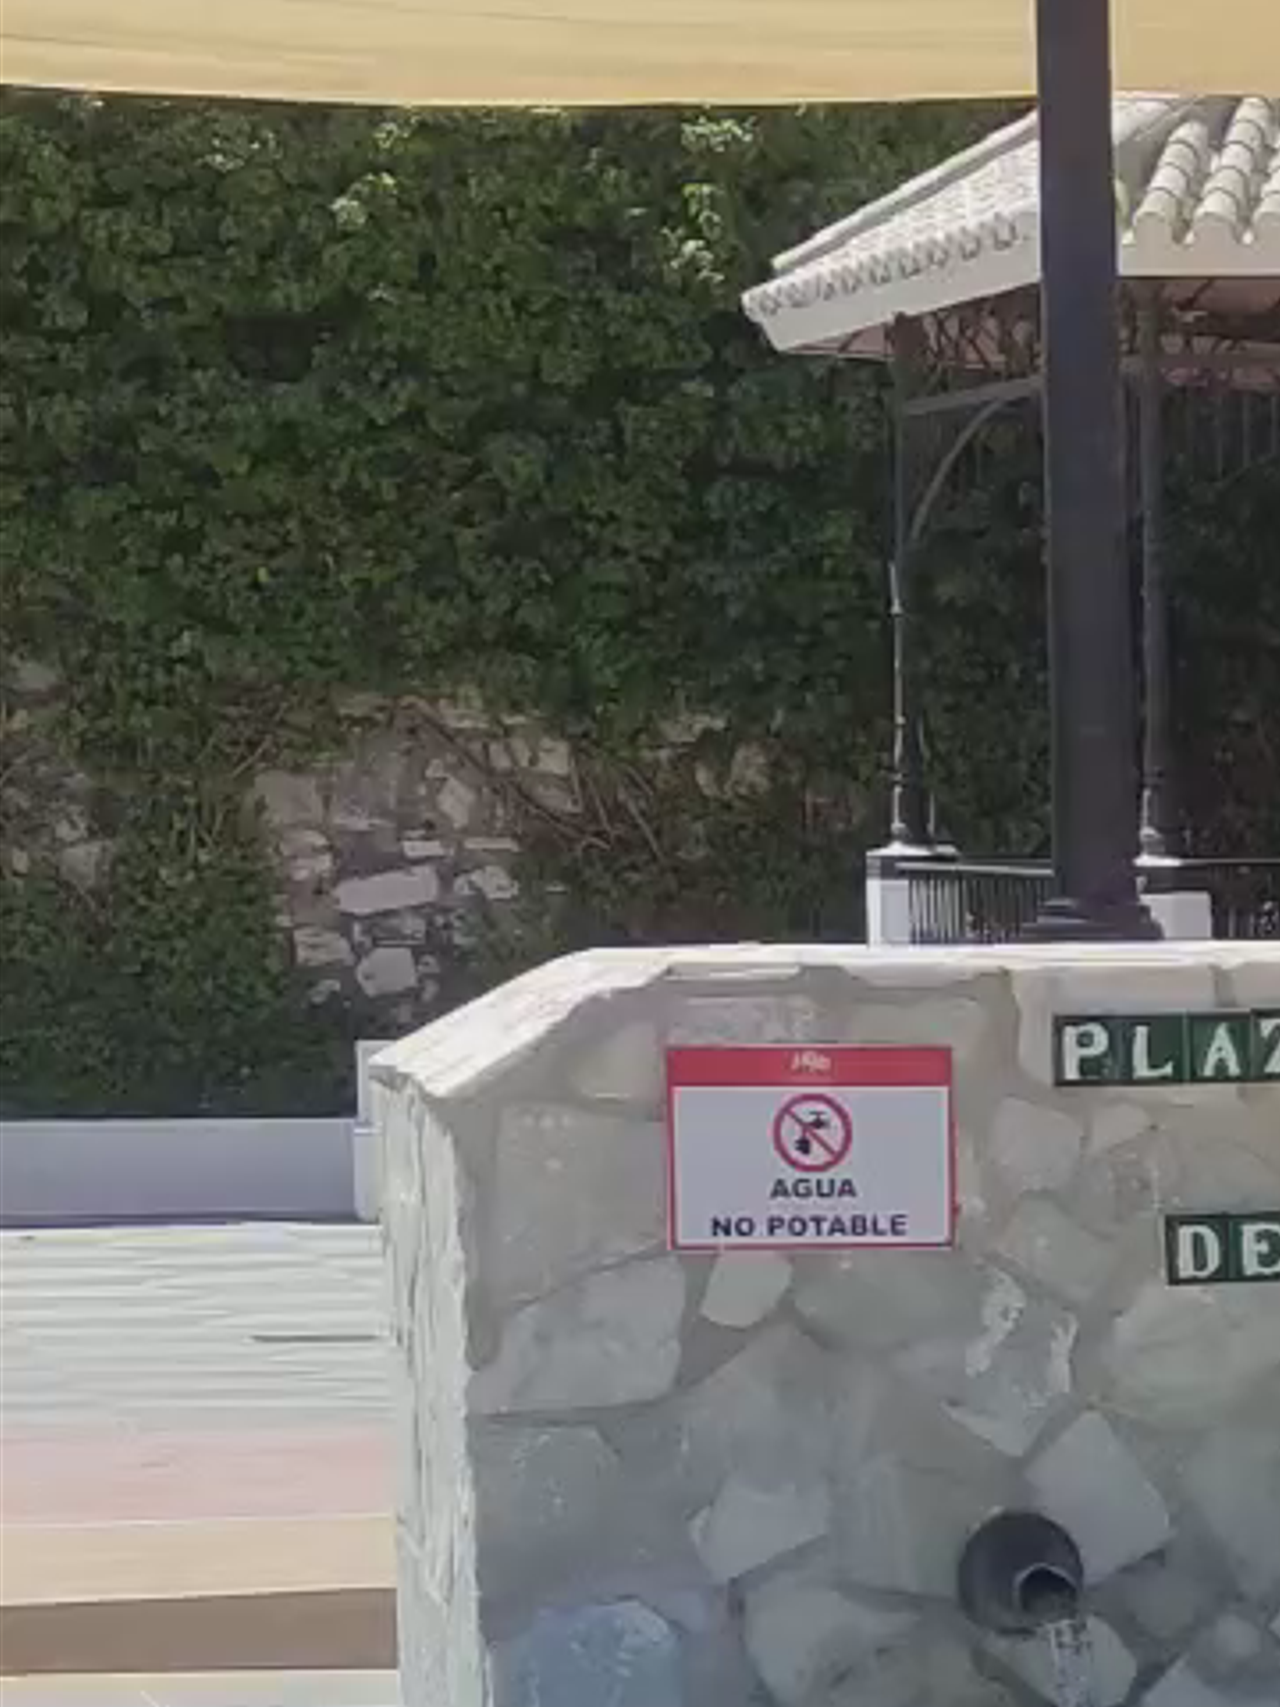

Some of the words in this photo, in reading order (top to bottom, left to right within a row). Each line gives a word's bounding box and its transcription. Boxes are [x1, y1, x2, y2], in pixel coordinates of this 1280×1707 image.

[769, 1177, 858, 1199] AGUA
[710, 1216, 755, 1237] NO
[766, 1213, 909, 1237] POTABLE
